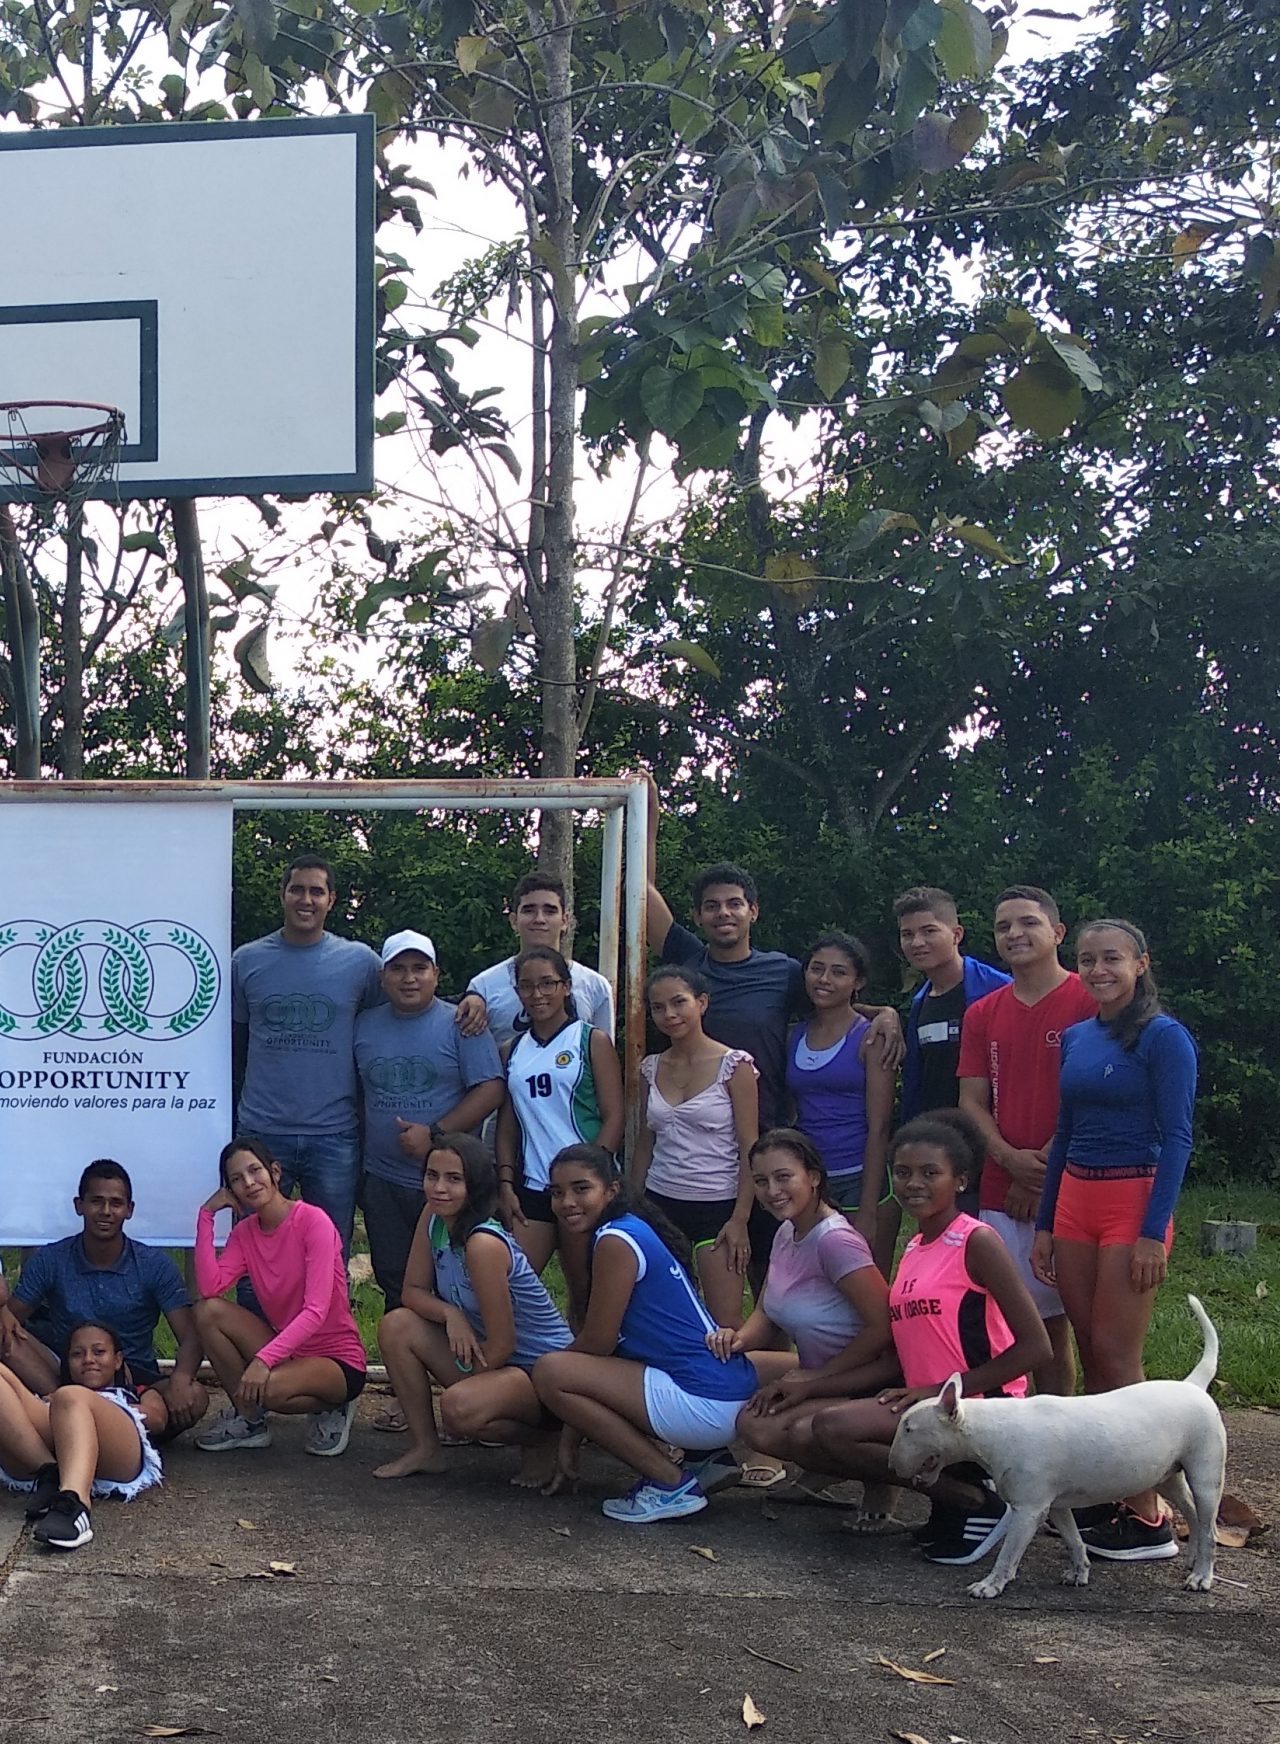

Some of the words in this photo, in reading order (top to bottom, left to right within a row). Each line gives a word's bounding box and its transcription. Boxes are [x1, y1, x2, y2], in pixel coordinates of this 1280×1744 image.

[266, 1037, 331, 1048] OPPORTUNITY
[42, 1049, 144, 1064] FUNDACIÓN
[525, 1072, 552, 1098] 19
[74, 1094, 128, 1109] valores
[131, 1098, 166, 1112] para
[171, 1095, 184, 1109] la
[188, 1098, 216, 1112] paz
[888, 1304, 902, 1322] AN
